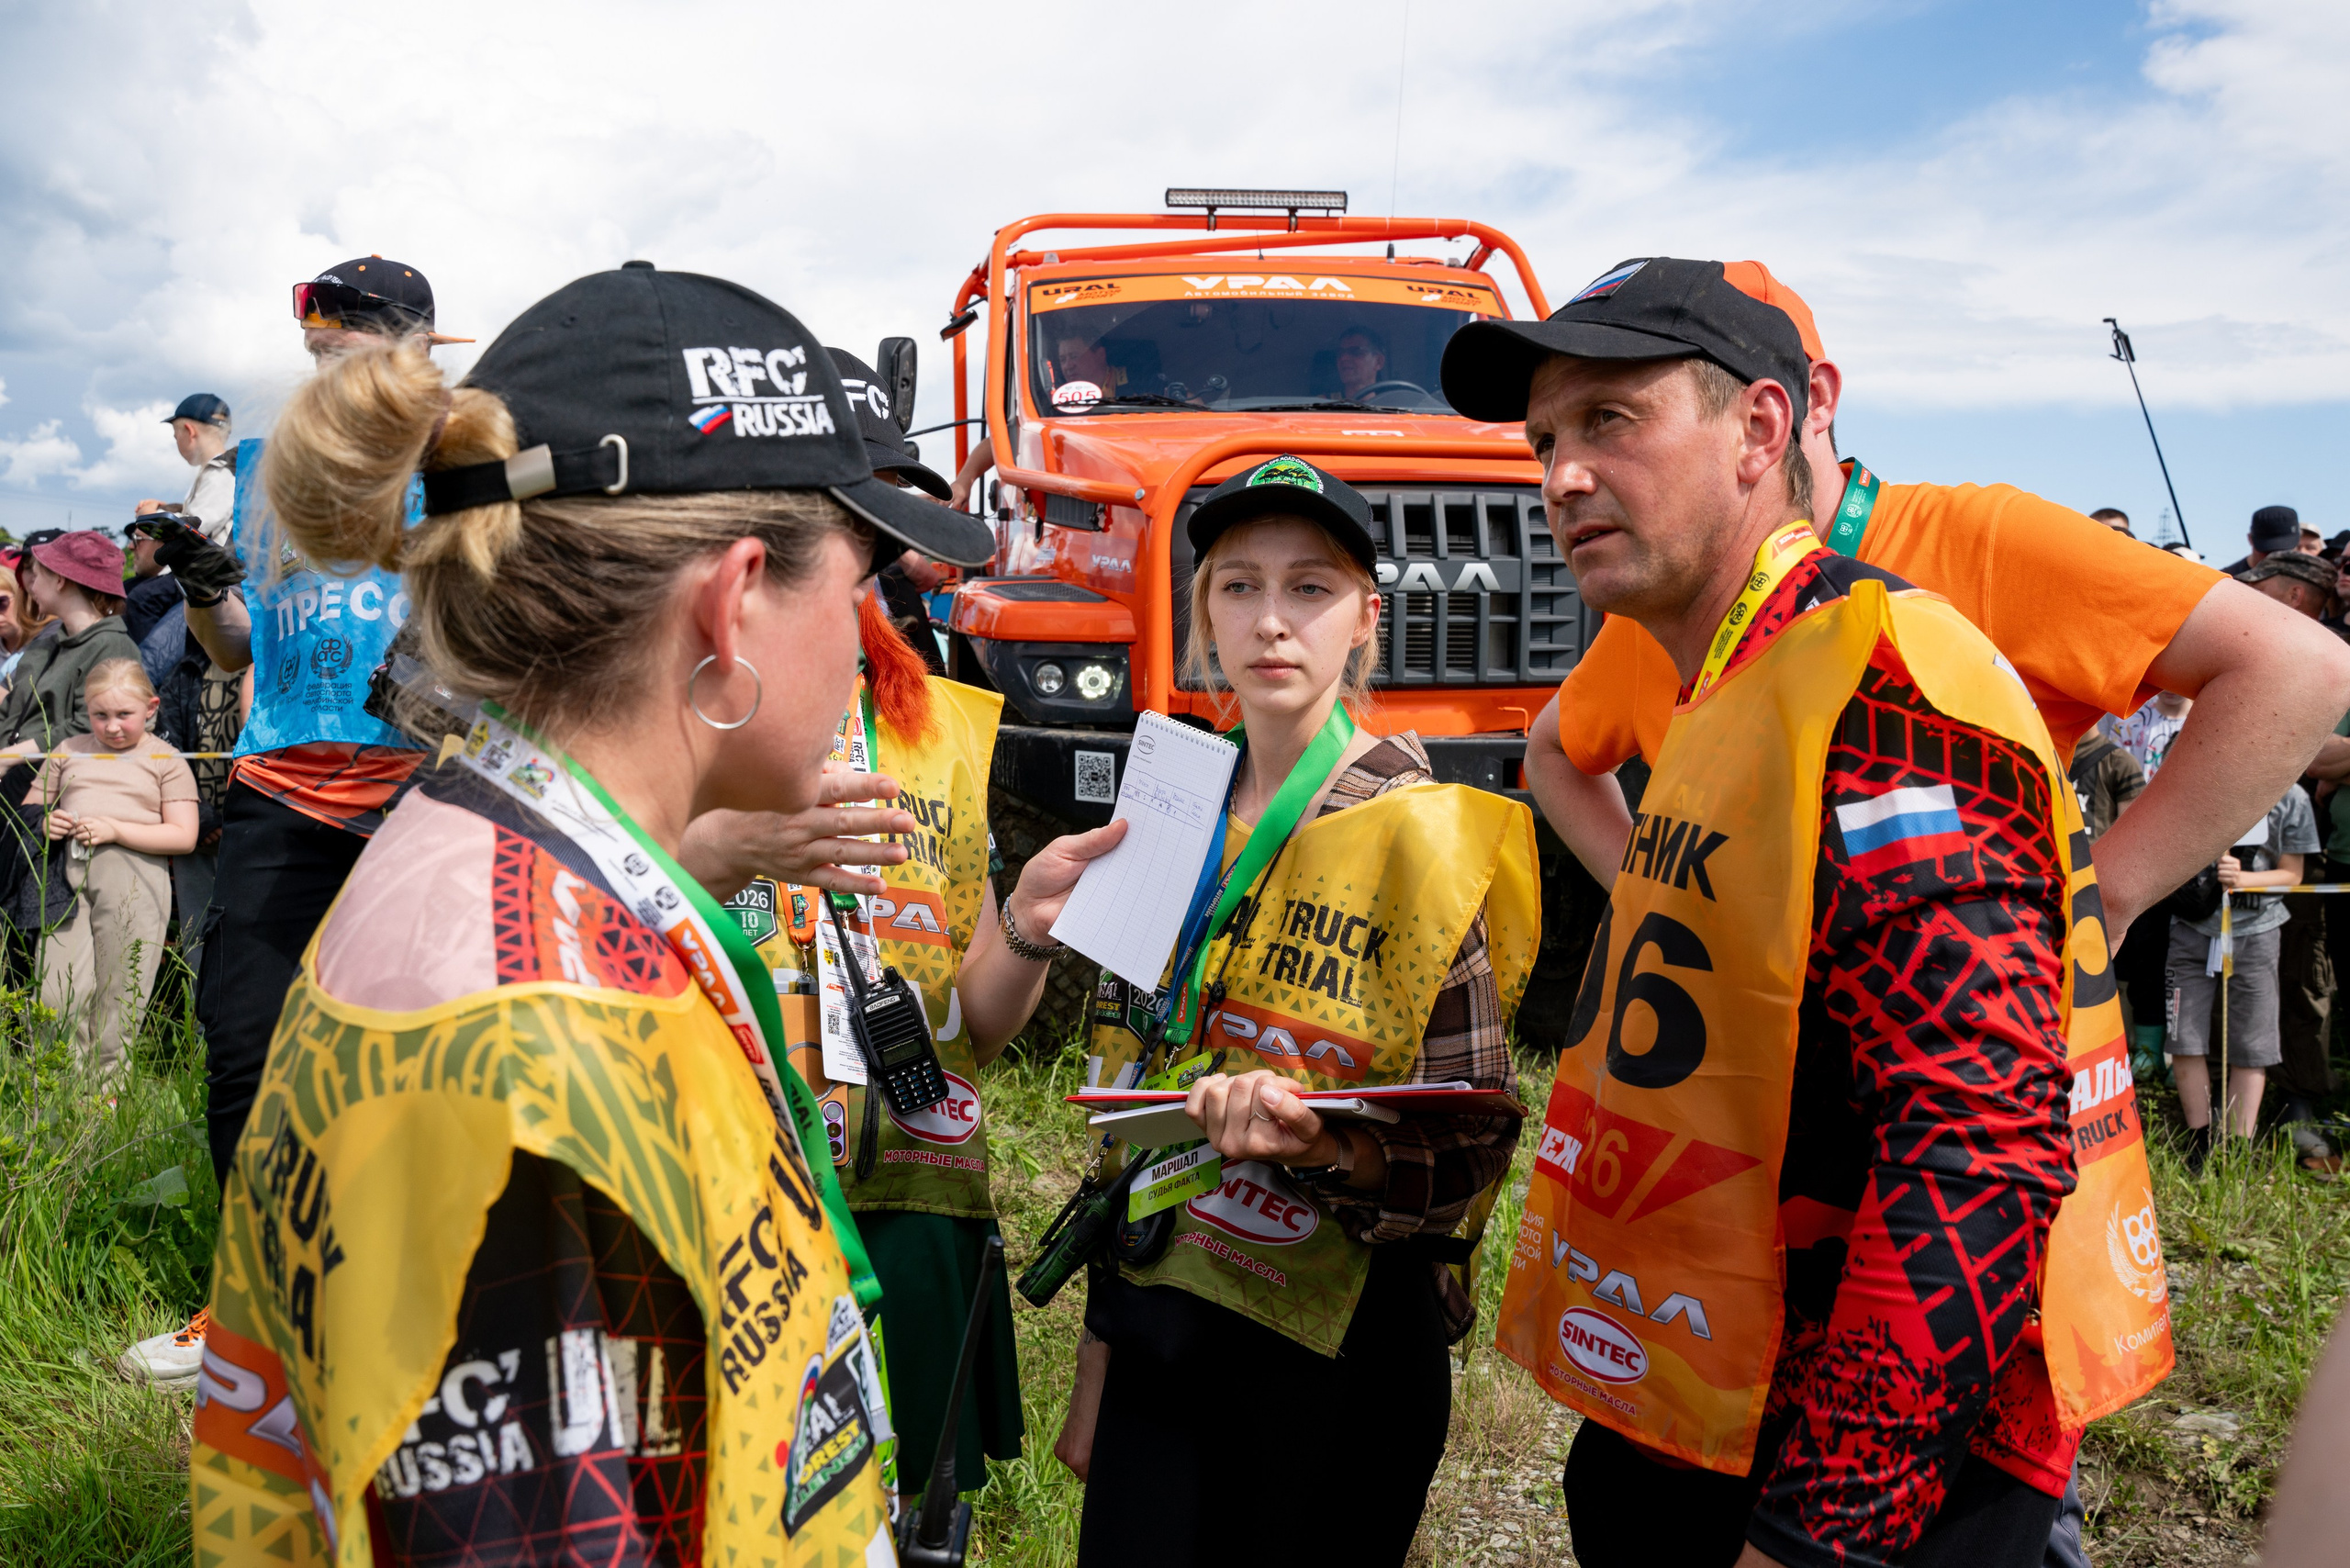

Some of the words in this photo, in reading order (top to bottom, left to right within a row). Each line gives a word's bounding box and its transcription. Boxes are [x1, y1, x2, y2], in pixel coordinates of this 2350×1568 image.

[1042, 283, 1121, 296] URAL
[1181, 275, 1352, 292] УРАЛ
[1406, 285, 1480, 300] URAL
[682, 345, 808, 398] RFC
[840, 377, 890, 420] FC
[733, 402, 836, 437] RUSSIA
[1091, 554, 1133, 574] УРАЛ
[1375, 562, 1502, 592] РАЛ
[1137, 739, 1155, 751] SINTEC
[725, 889, 769, 909] 026
[740, 911, 760, 929] 10
[1279, 899, 1390, 969] TRUCK
[1259, 941, 1363, 1010] TRIAL
[868, 996, 896, 1011] BAOFENG
[883, 1149, 953, 1168] МОТОРНЫЕ
[954, 1155, 986, 1173] МАСЛА
[1151, 1151, 1199, 1182] МАРШАЛ
[1147, 1182, 1173, 1201] СУДЬЯ
[1173, 1171, 1201, 1194] ФАКТА
[1229, 1249, 1286, 1287] МАСЛА
[1551, 1226, 1713, 1341] УРАЛ
[1561, 1319, 1641, 1373] SINTEC
[1549, 1362, 1598, 1397] МОТОРНЫЕ
[1599, 1391, 1638, 1417] МАСЛА
